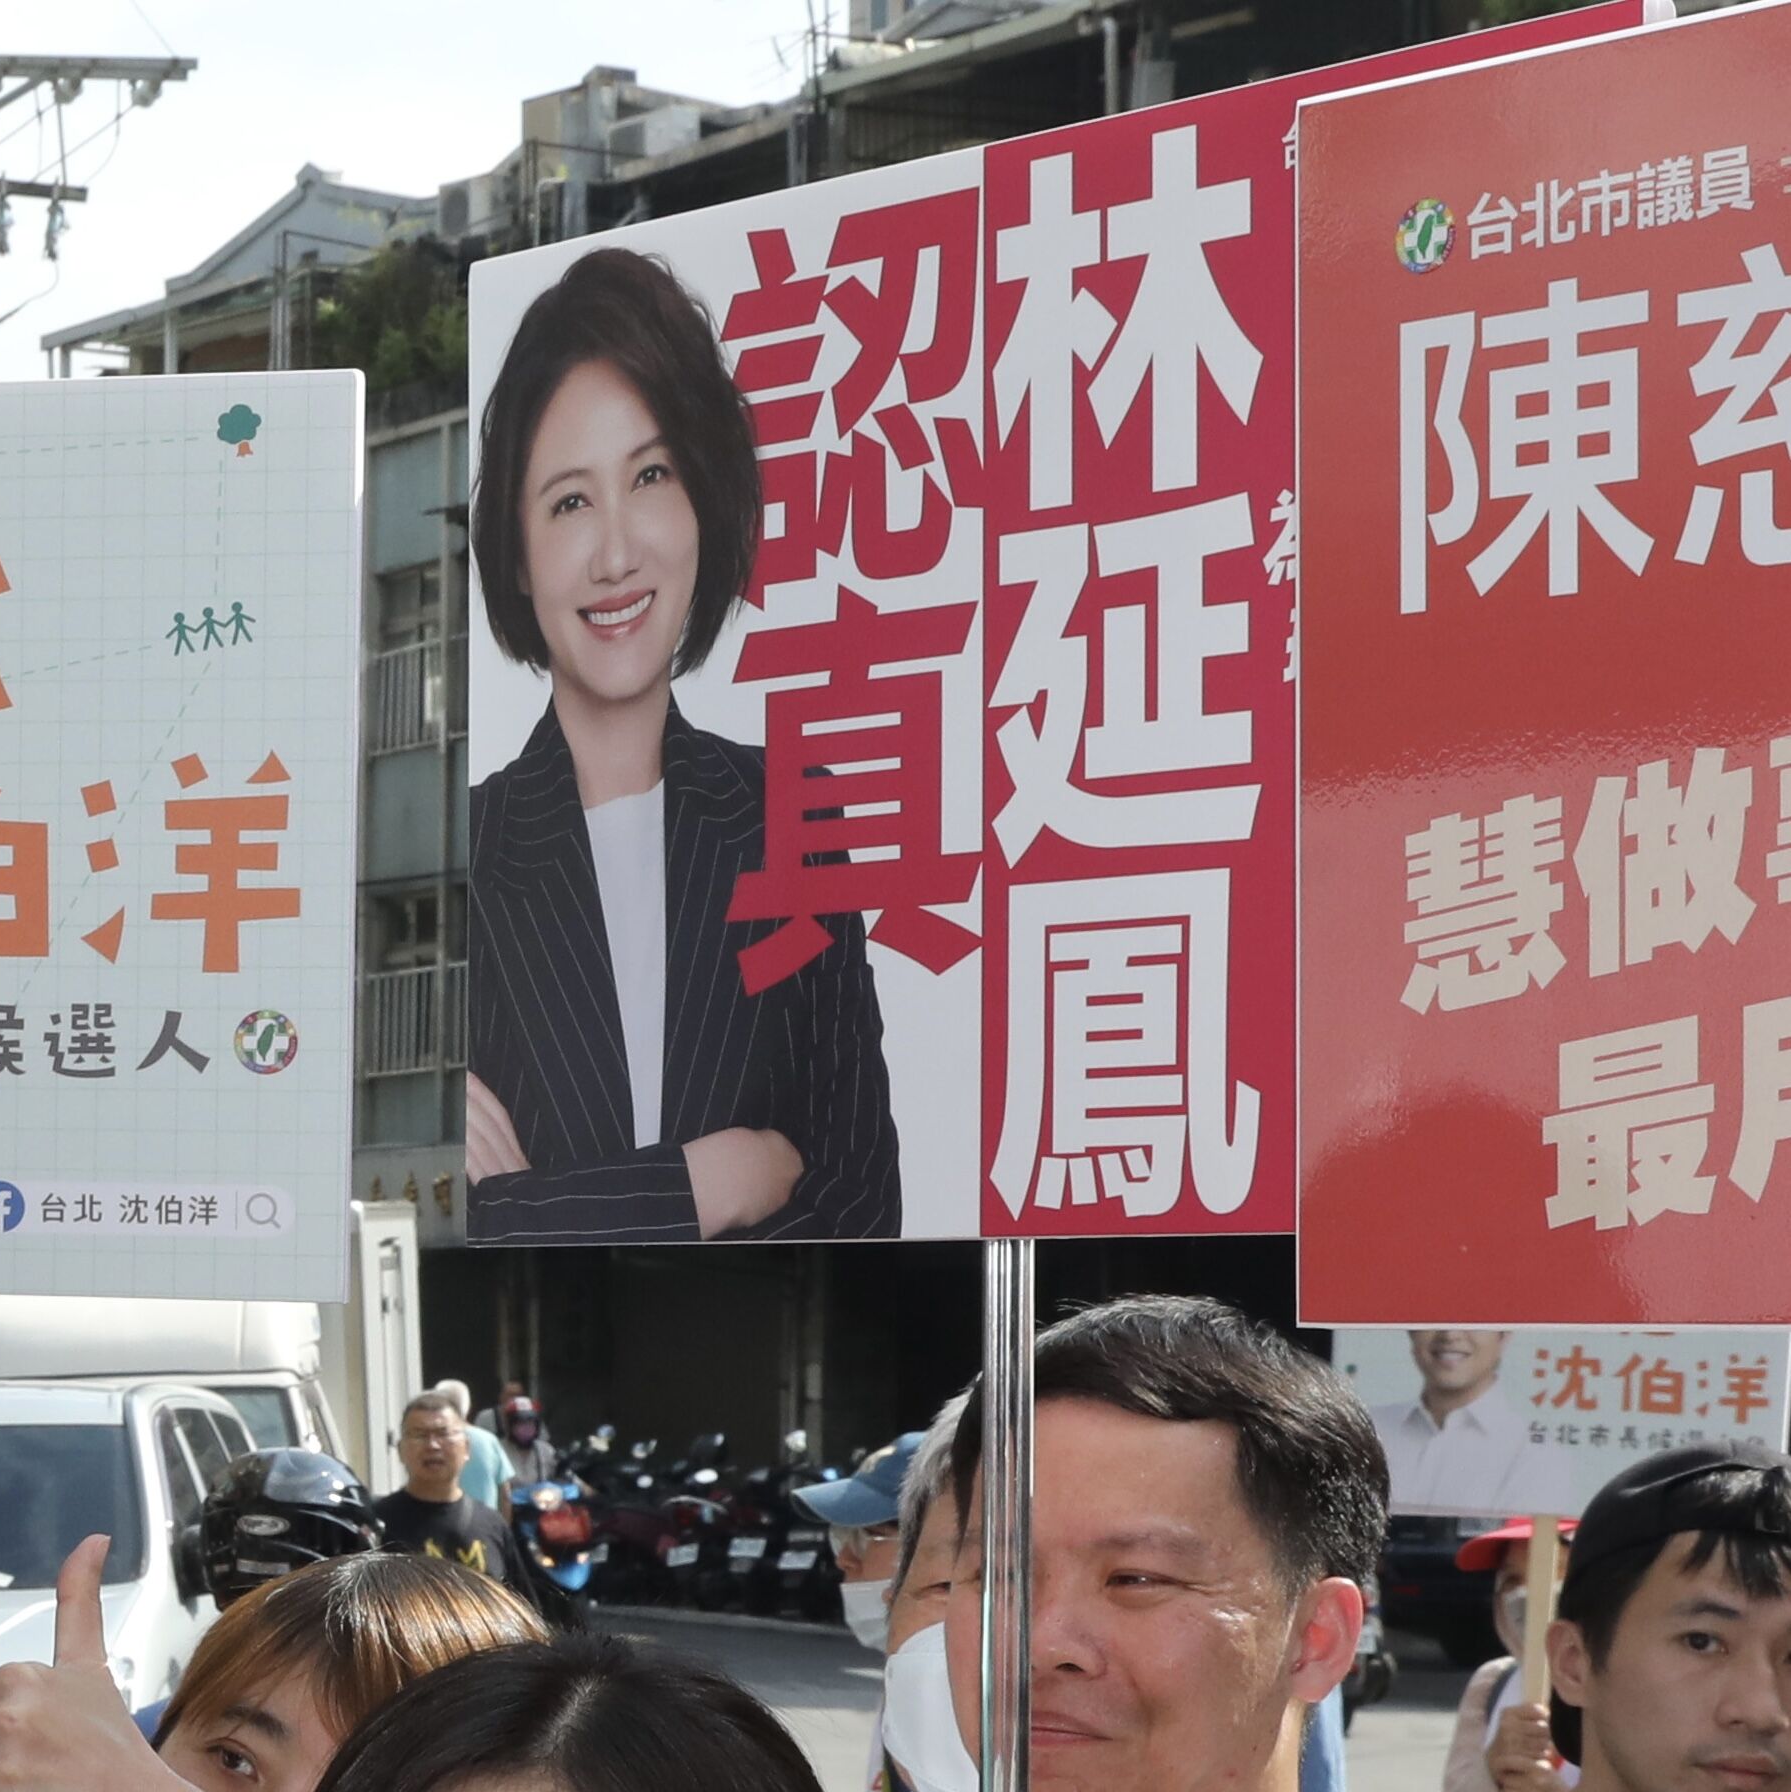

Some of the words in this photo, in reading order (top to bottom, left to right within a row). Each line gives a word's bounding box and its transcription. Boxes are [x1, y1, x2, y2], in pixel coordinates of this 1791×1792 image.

[1465, 145, 1756, 260] 台北市議員
[719, 181, 985, 997] 認真
[989, 125, 1265, 1223] 林延鳳
[1400, 735, 1791, 1015] 慧做
[41, 1193, 103, 1224] 台北
[119, 1194, 219, 1226] 沈伯洋
[1528, 1345, 1771, 1425] 沈伯洋
